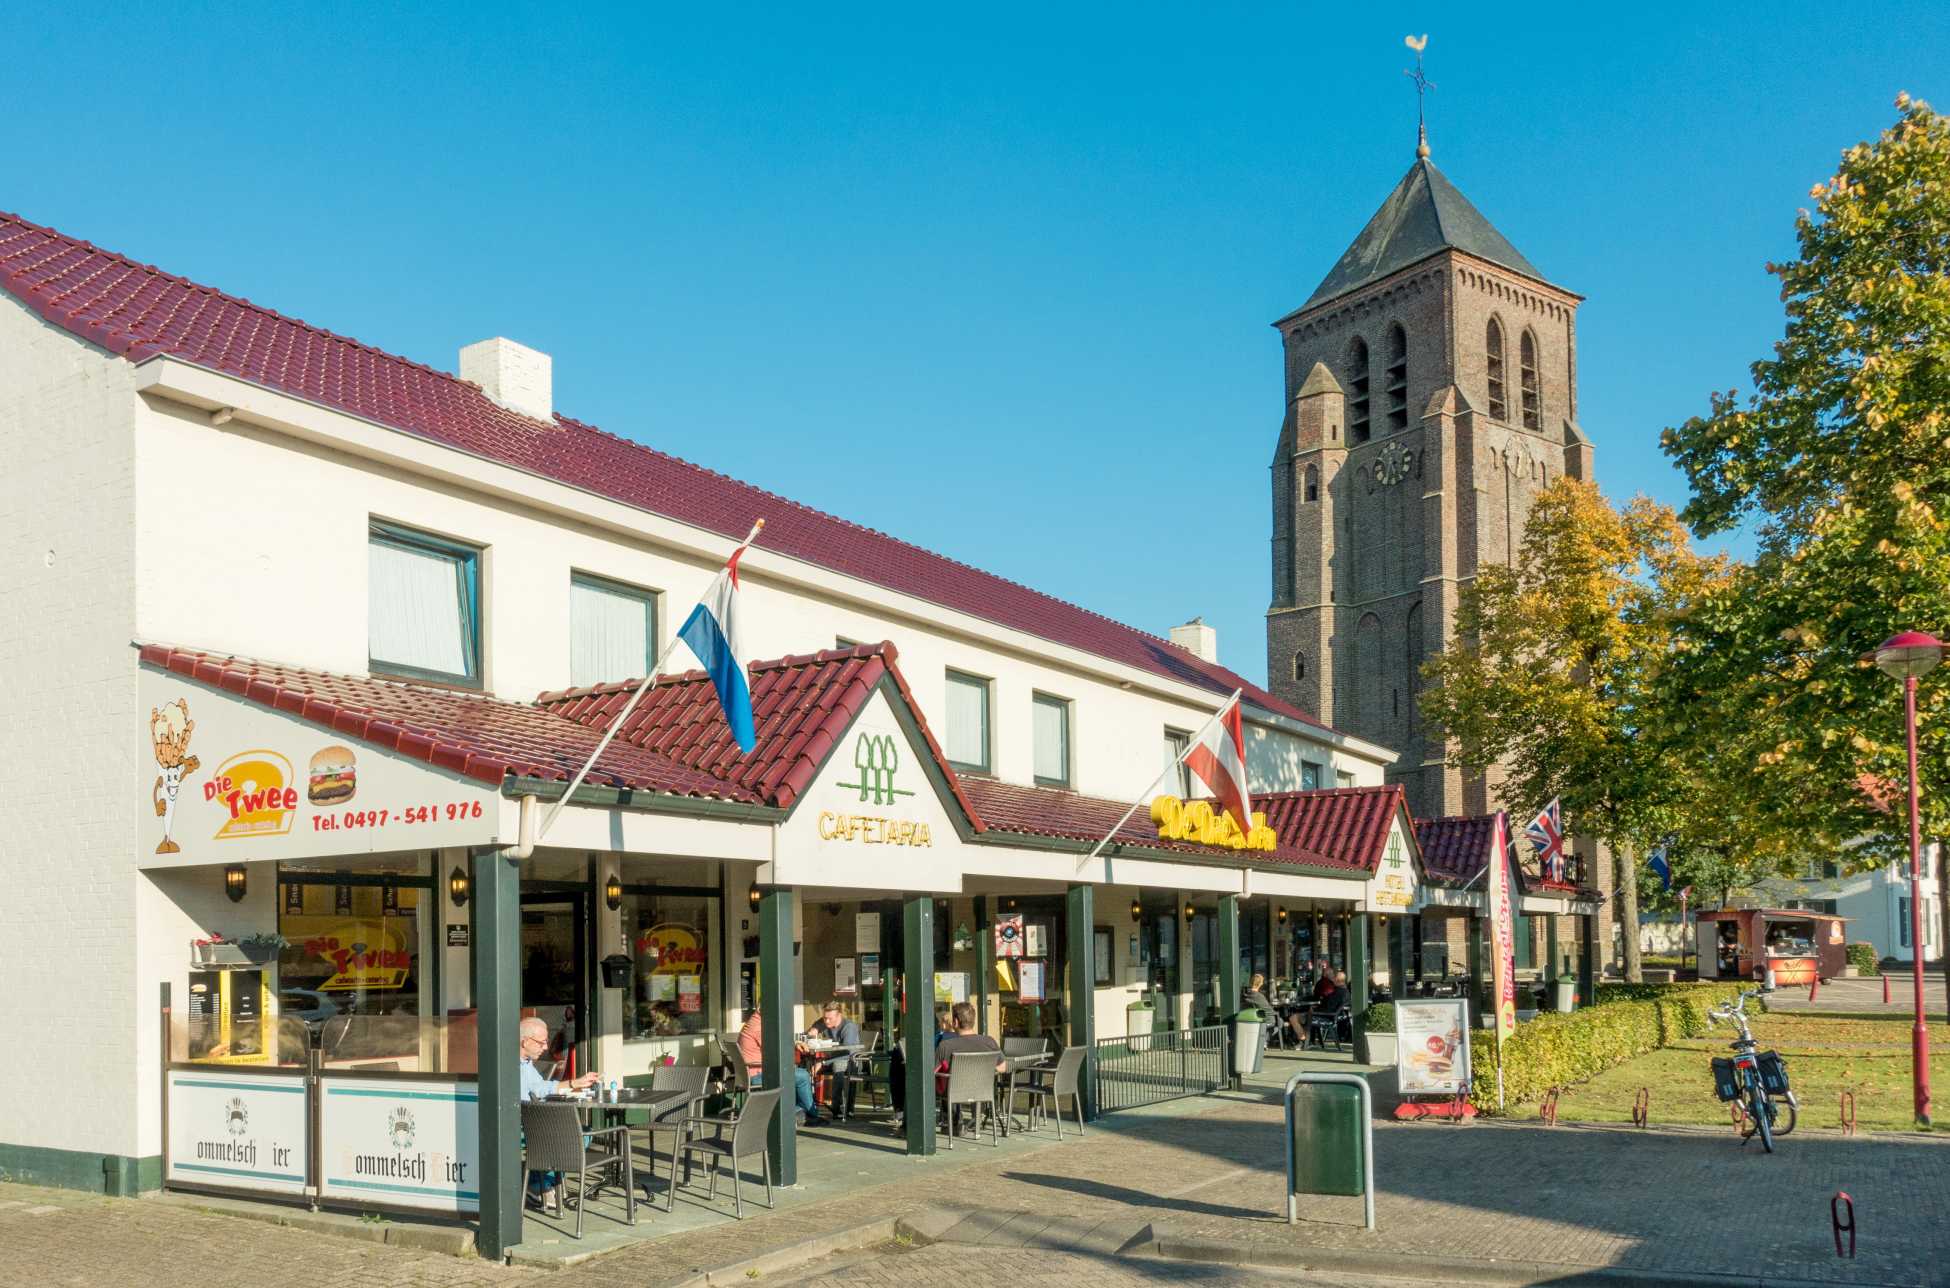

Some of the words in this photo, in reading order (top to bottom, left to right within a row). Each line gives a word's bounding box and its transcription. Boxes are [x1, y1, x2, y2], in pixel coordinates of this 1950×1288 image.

[203, 776, 233, 801] Die
[225, 787, 298, 819] Twee
[312, 814, 340, 832] Tel.
[343, 809, 389, 829] 0497
[404, 805, 438, 824] 541
[446, 800, 483, 820] 976
[818, 809, 932, 848] CAFETARIA
